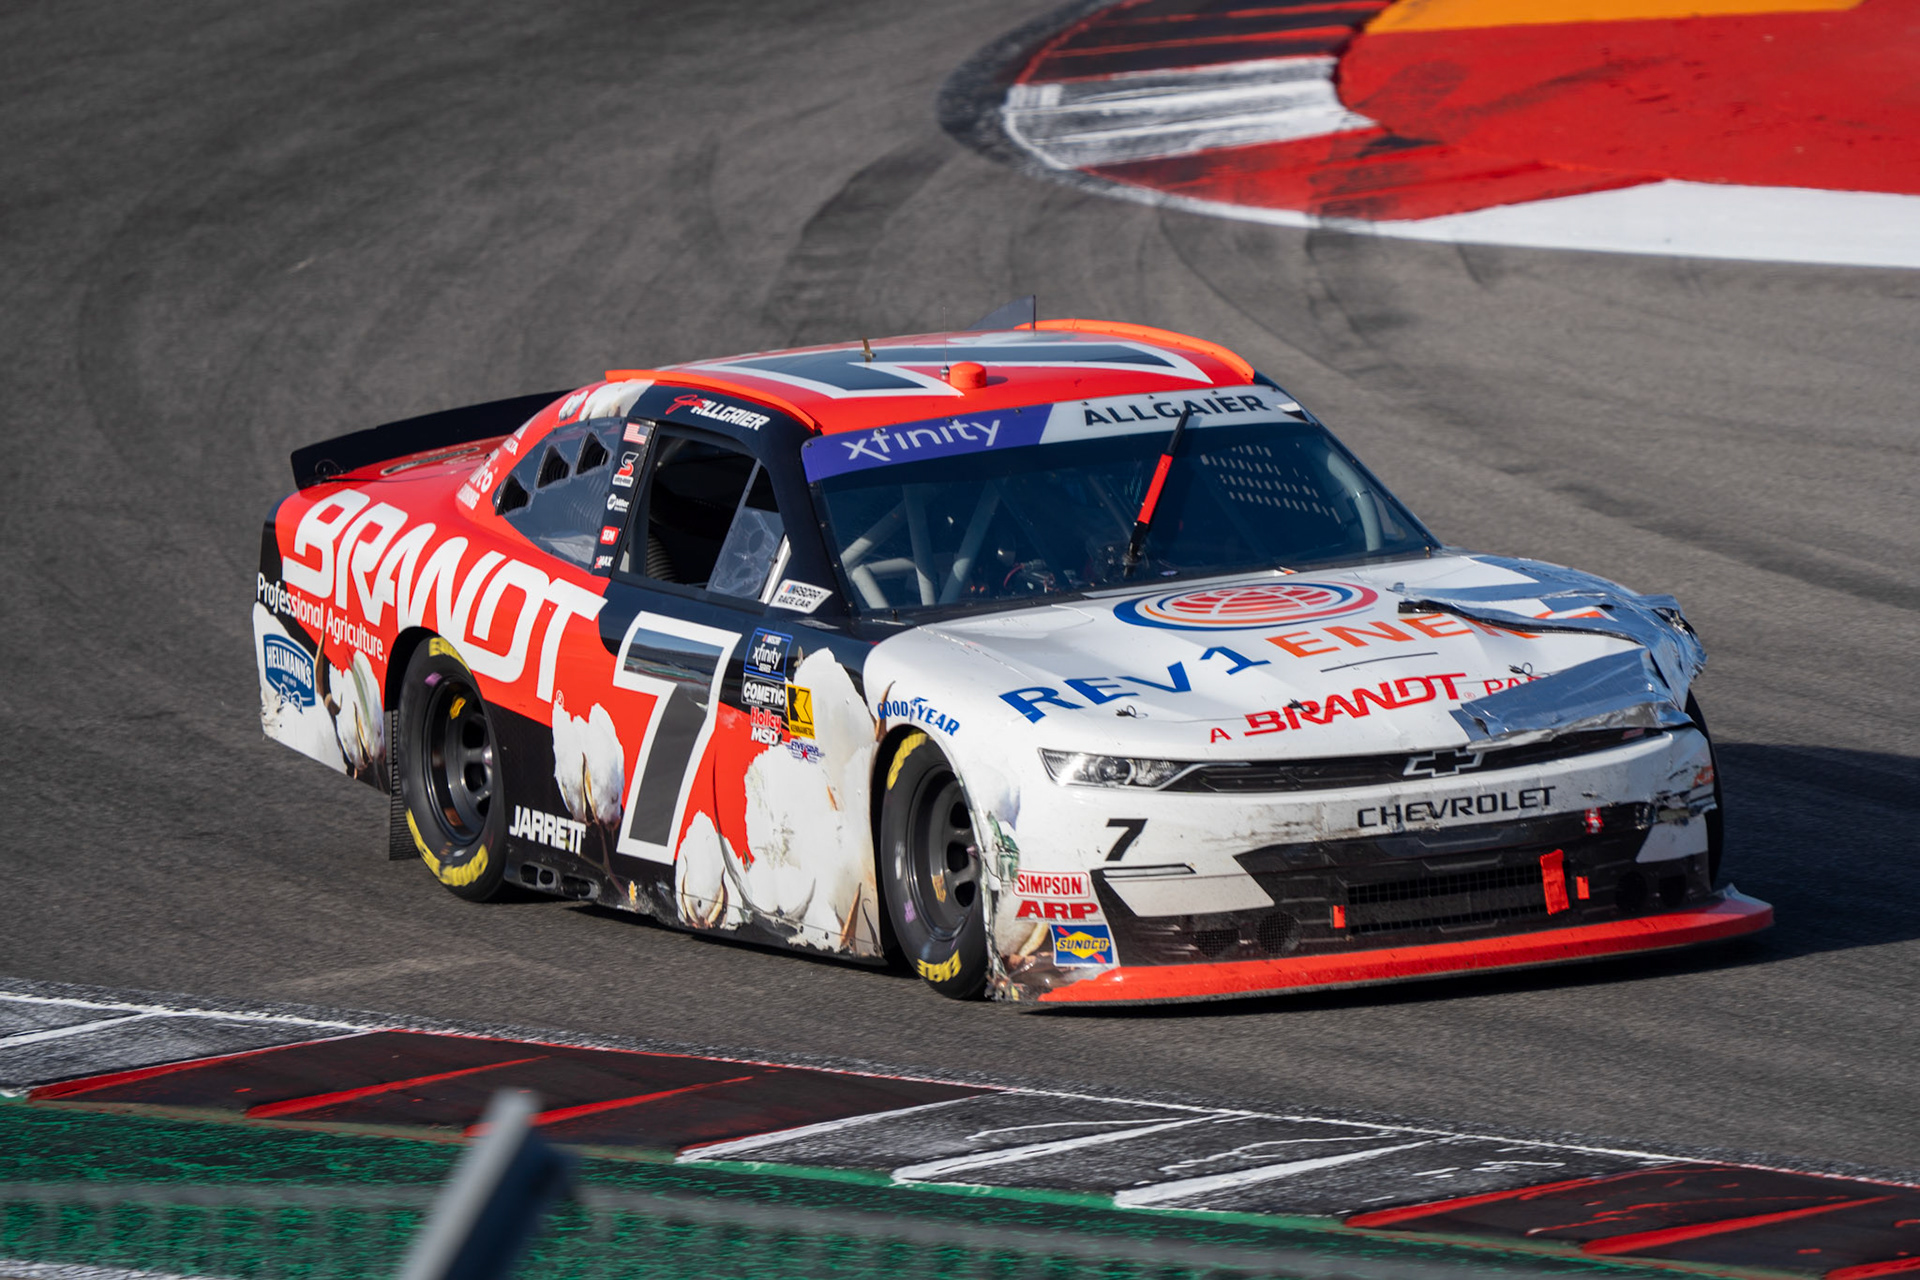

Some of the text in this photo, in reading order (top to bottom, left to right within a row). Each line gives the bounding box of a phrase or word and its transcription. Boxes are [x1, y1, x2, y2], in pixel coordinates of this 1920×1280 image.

[690, 400, 770, 431] ALLGAIER
[1084, 395, 1271, 426] ALLGAIER
[841, 419, 1000, 461] xfinity
[281, 489, 609, 703] BRANDT
[257, 572, 324, 630] Professional
[326, 608, 383, 660] Agriculture
[266, 646, 312, 690] HELLMANN'S
[753, 643, 782, 670] xfinity
[743, 682, 785, 705] COMETIC
[1210, 727, 1232, 743] A
[1244, 673, 1468, 737] BRANDT
[751, 706, 781, 733] Holley
[751, 726, 779, 746] MSD
[612, 611, 742, 866] 7
[1357, 786, 1557, 828] CHEVROLET
[509, 805, 586, 854] JARRETT
[1105, 818, 1148, 861] 7
[1018, 874, 1082, 895] SIMPSON
[1016, 900, 1098, 919] ARP
[1059, 939, 1107, 950] SUNOCO
